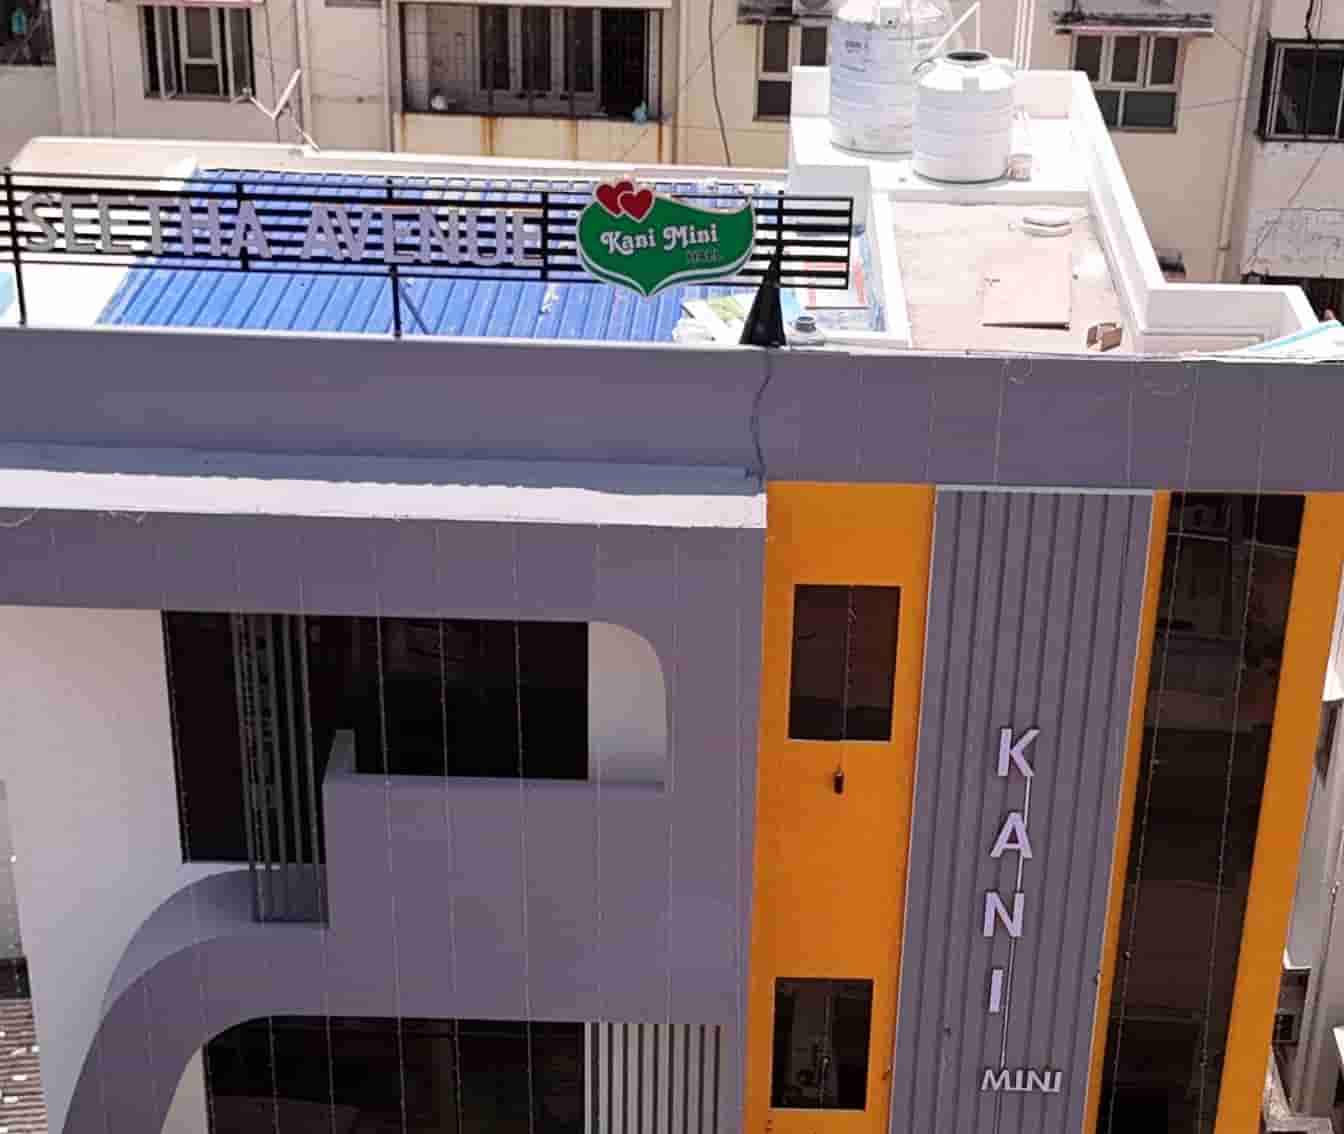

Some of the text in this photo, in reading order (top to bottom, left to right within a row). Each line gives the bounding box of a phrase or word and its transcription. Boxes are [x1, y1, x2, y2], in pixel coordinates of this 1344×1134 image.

[22, 193, 544, 267] SEETHA AVENUE
[600, 223, 719, 256] Kani Mini
[981, 727, 1042, 1014] KANI
[981, 1067, 1063, 1094] MINI
